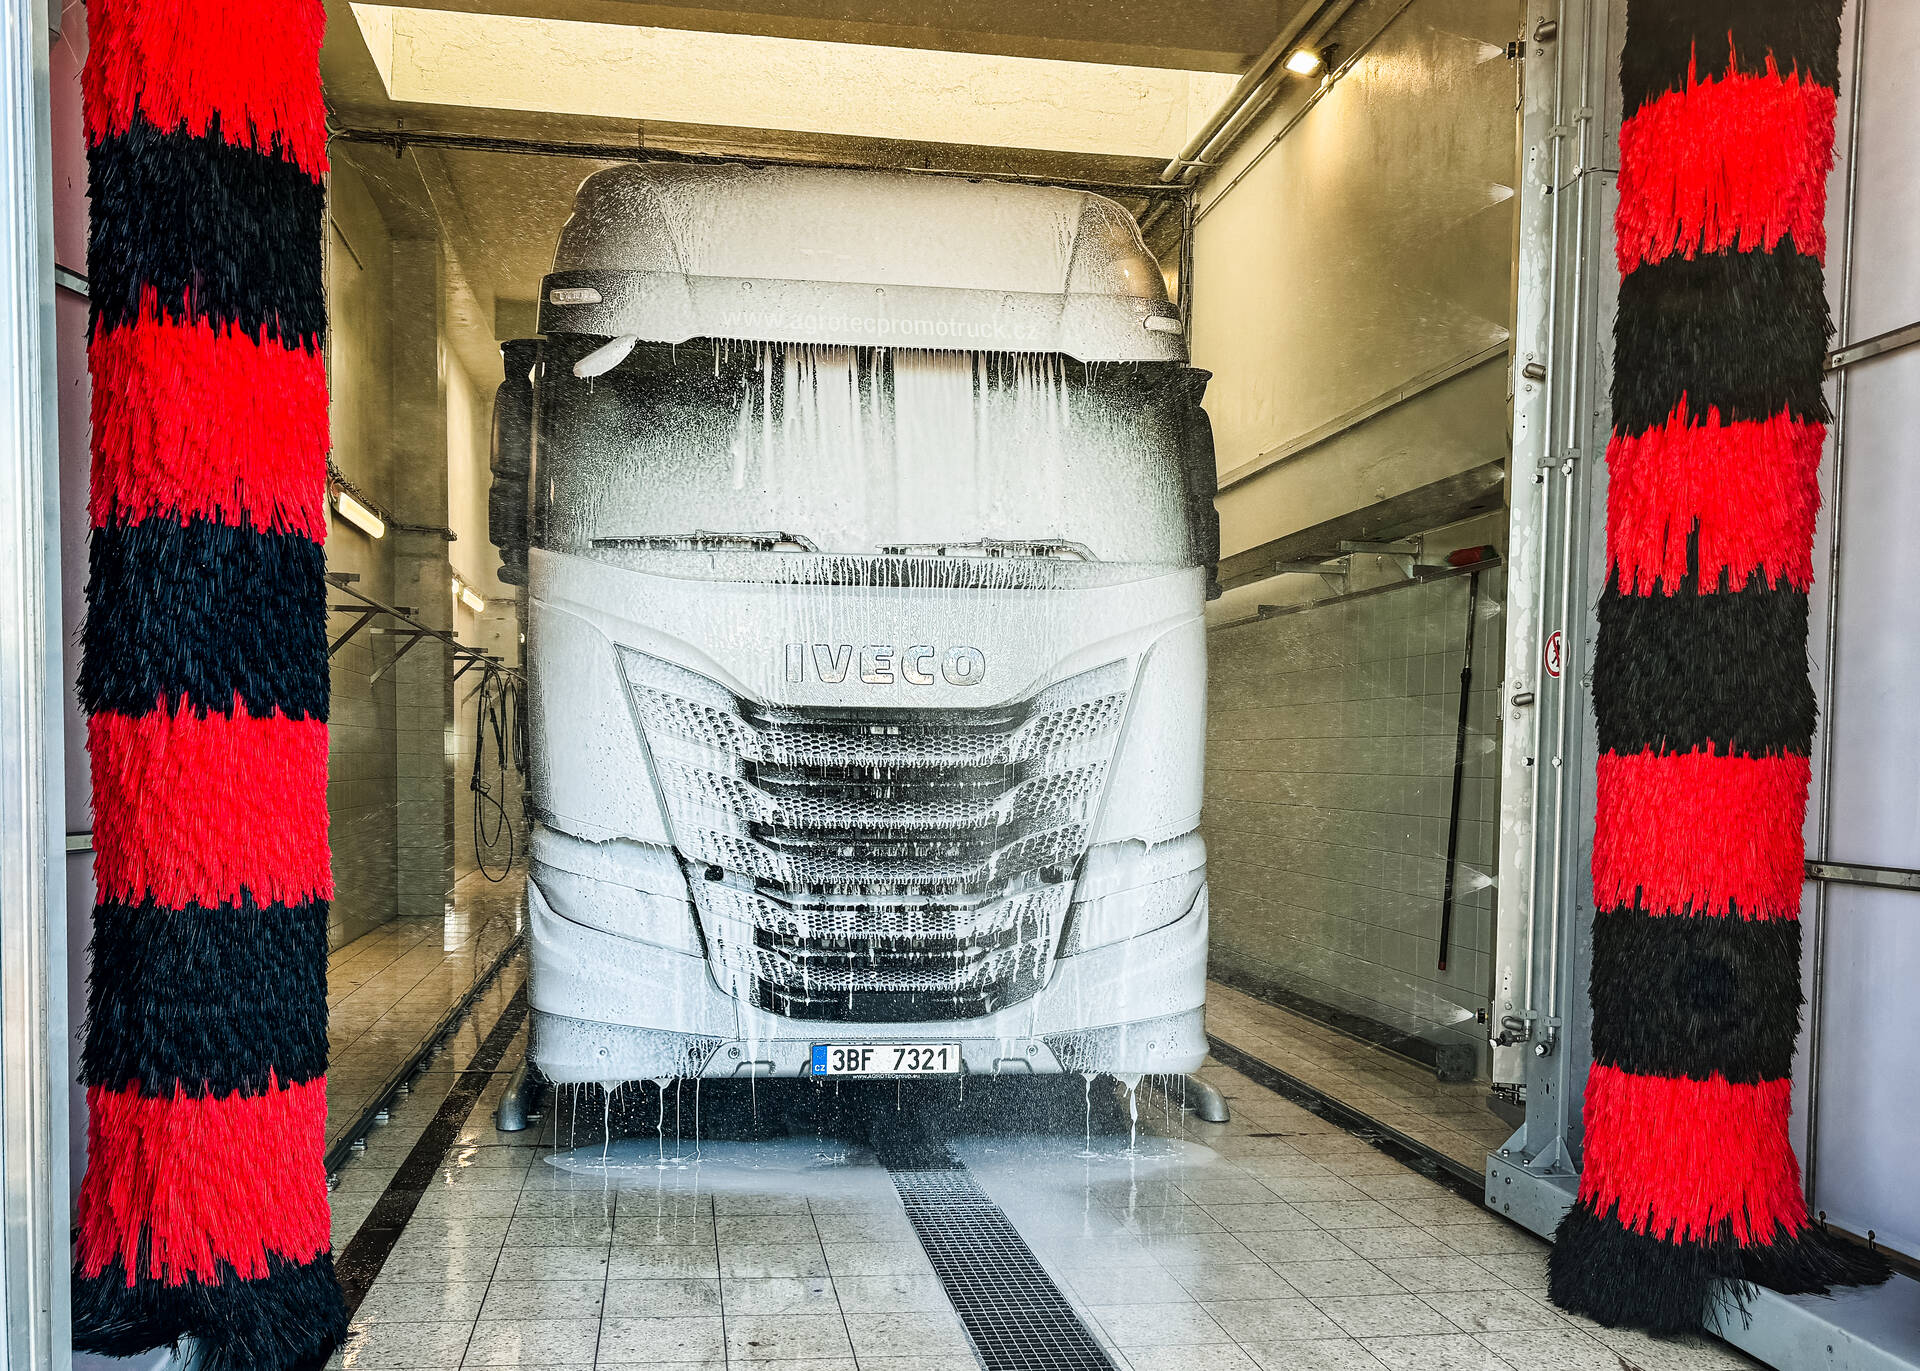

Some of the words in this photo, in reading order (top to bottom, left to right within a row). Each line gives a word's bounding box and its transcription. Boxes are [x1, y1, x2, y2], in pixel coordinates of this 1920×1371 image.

[786, 644, 986, 686] IVECO
[814, 1064, 826, 1072] CZ
[832, 1048, 874, 1071] 3BF
[893, 1048, 947, 1071] 7321
